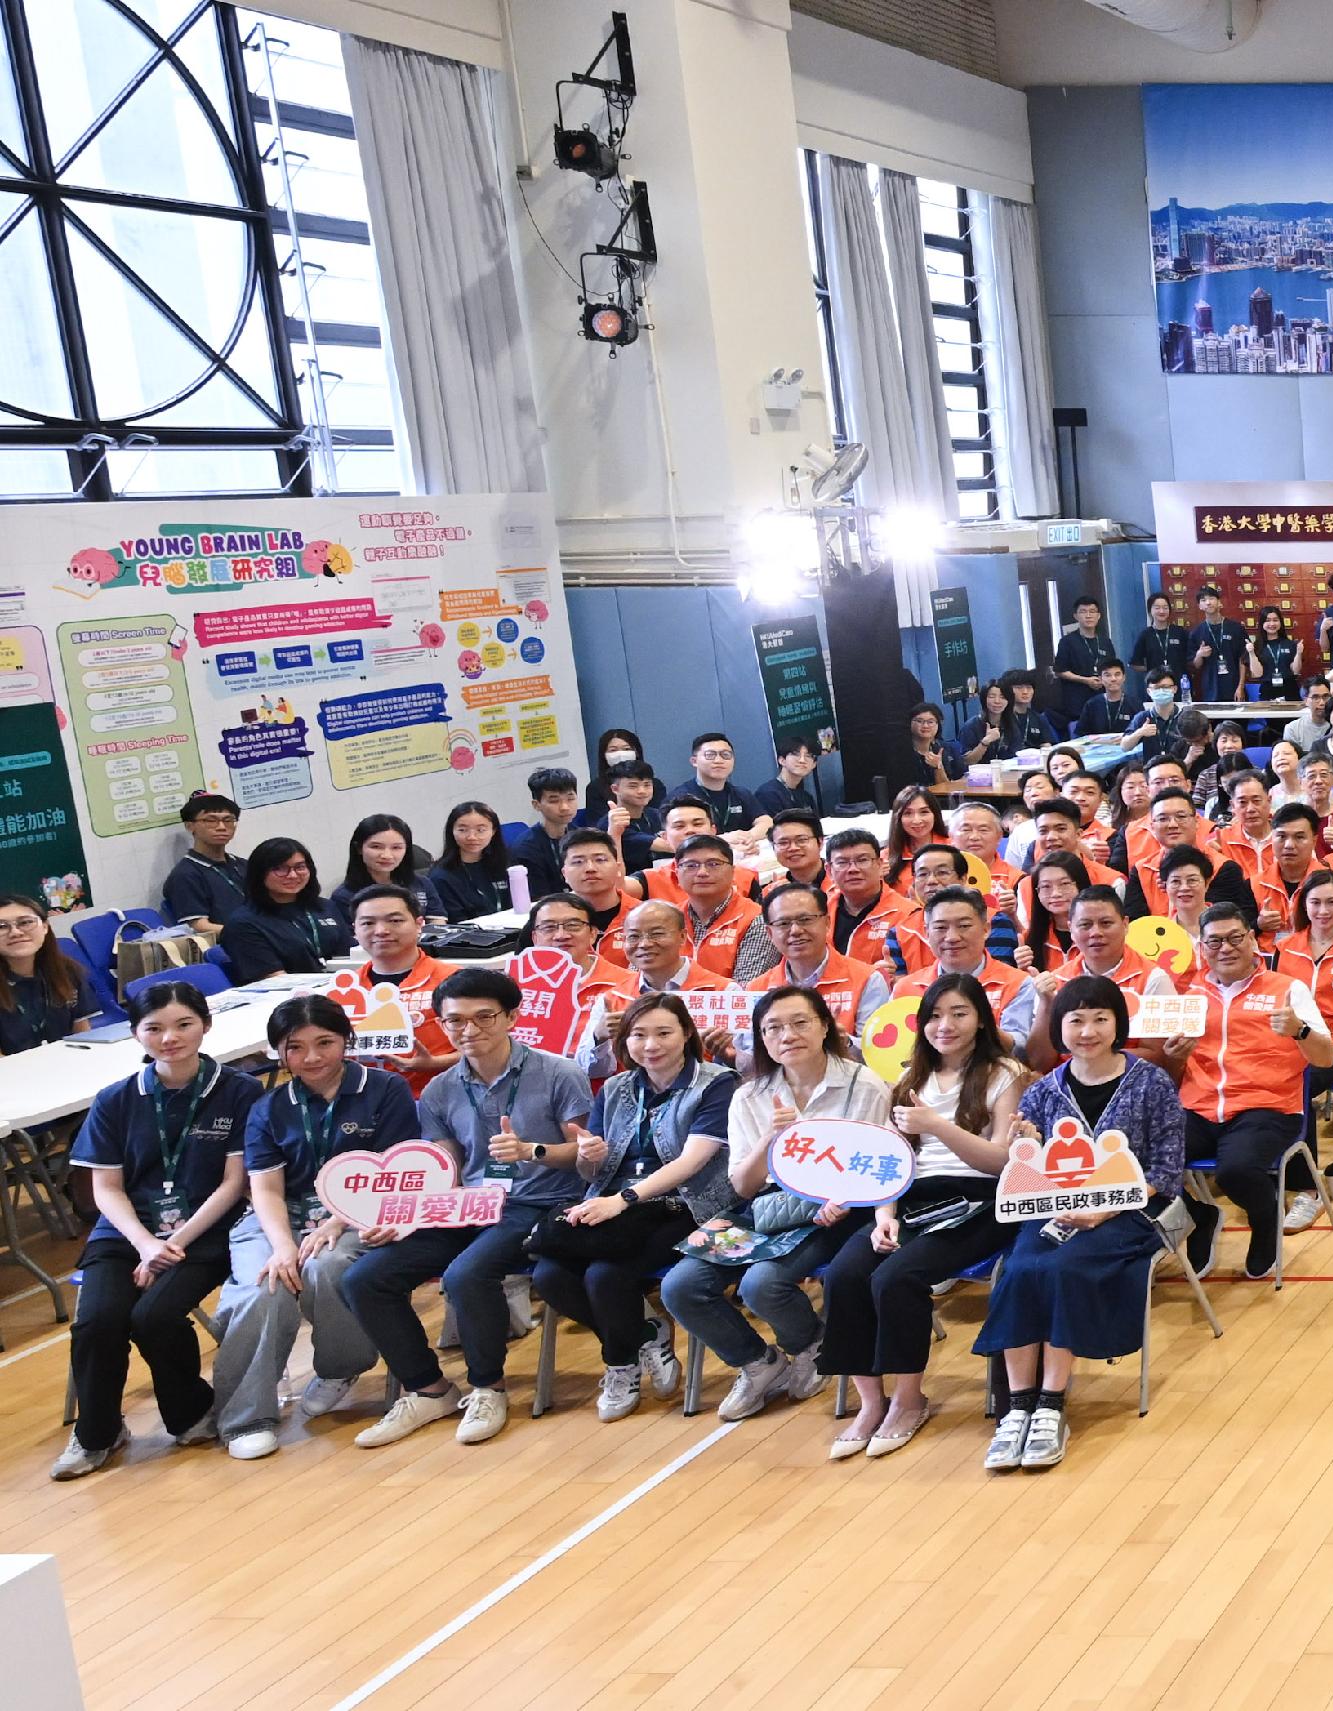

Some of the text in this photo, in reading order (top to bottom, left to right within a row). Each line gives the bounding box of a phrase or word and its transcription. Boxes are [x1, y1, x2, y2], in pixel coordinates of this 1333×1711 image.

[120, 531, 304, 559] YOUNG BRAIN LAB
[1048, 524, 1081, 544] EXIT 出口
[138, 556, 298, 588] 兒腦發展研究組
[111, 627, 167, 640] Screen Time
[127, 734, 189, 752] Sleeping Time
[1145, 998, 1200, 1014] 中西區
[1142, 1017, 1201, 1034] 關愛隊
[782, 1131, 903, 1187] 好人好事
[343, 1169, 427, 1195] 中西區
[376, 1187, 503, 1227] 關愛隊
[999, 1186, 1144, 1215] 中西區民政事務處
